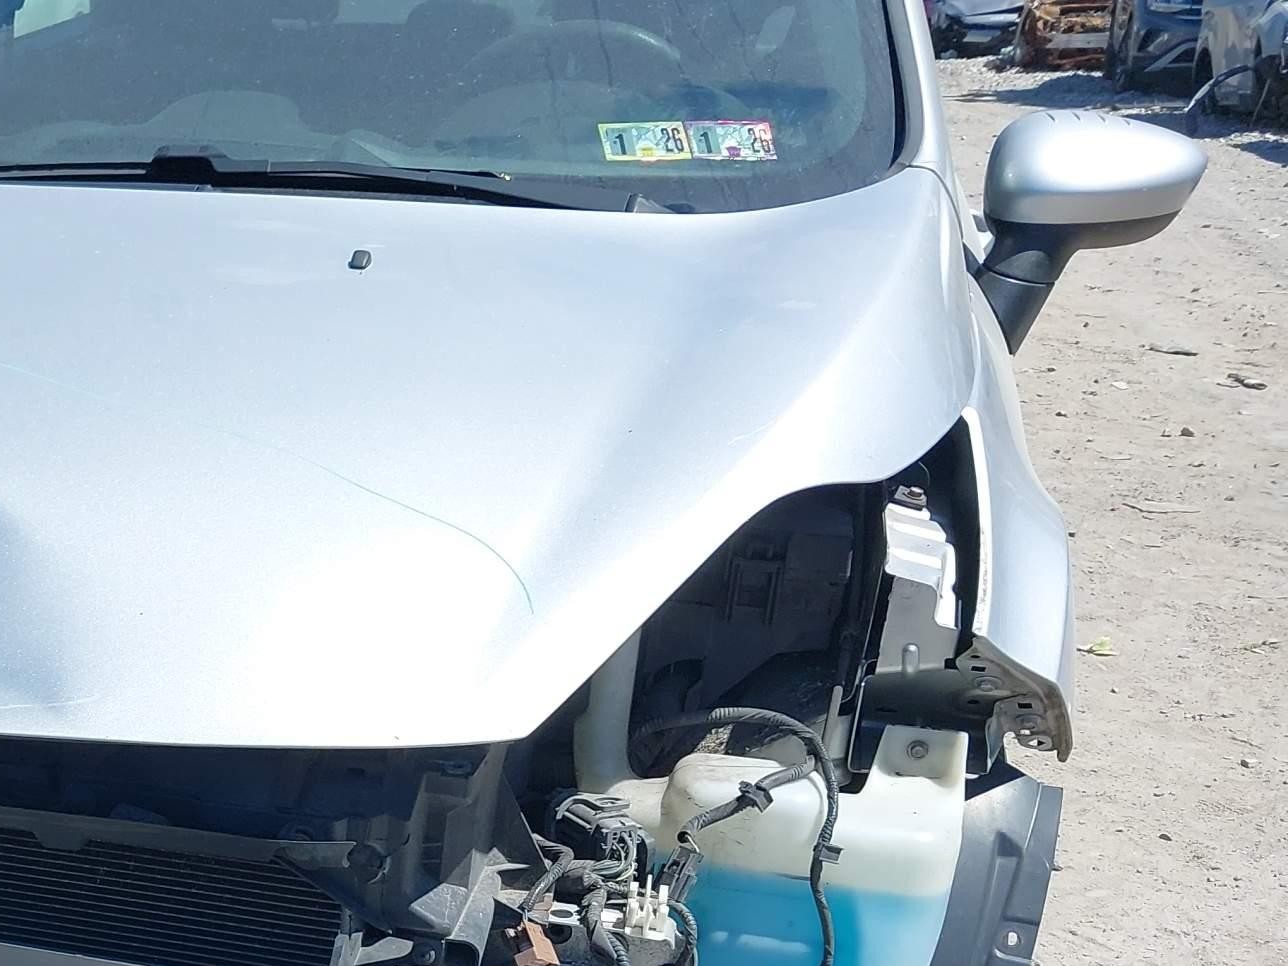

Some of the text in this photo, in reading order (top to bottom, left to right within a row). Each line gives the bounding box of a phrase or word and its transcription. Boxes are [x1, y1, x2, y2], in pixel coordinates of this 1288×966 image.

[614, 127, 685, 155] 1 26
[700, 127, 771, 154] 1 26
